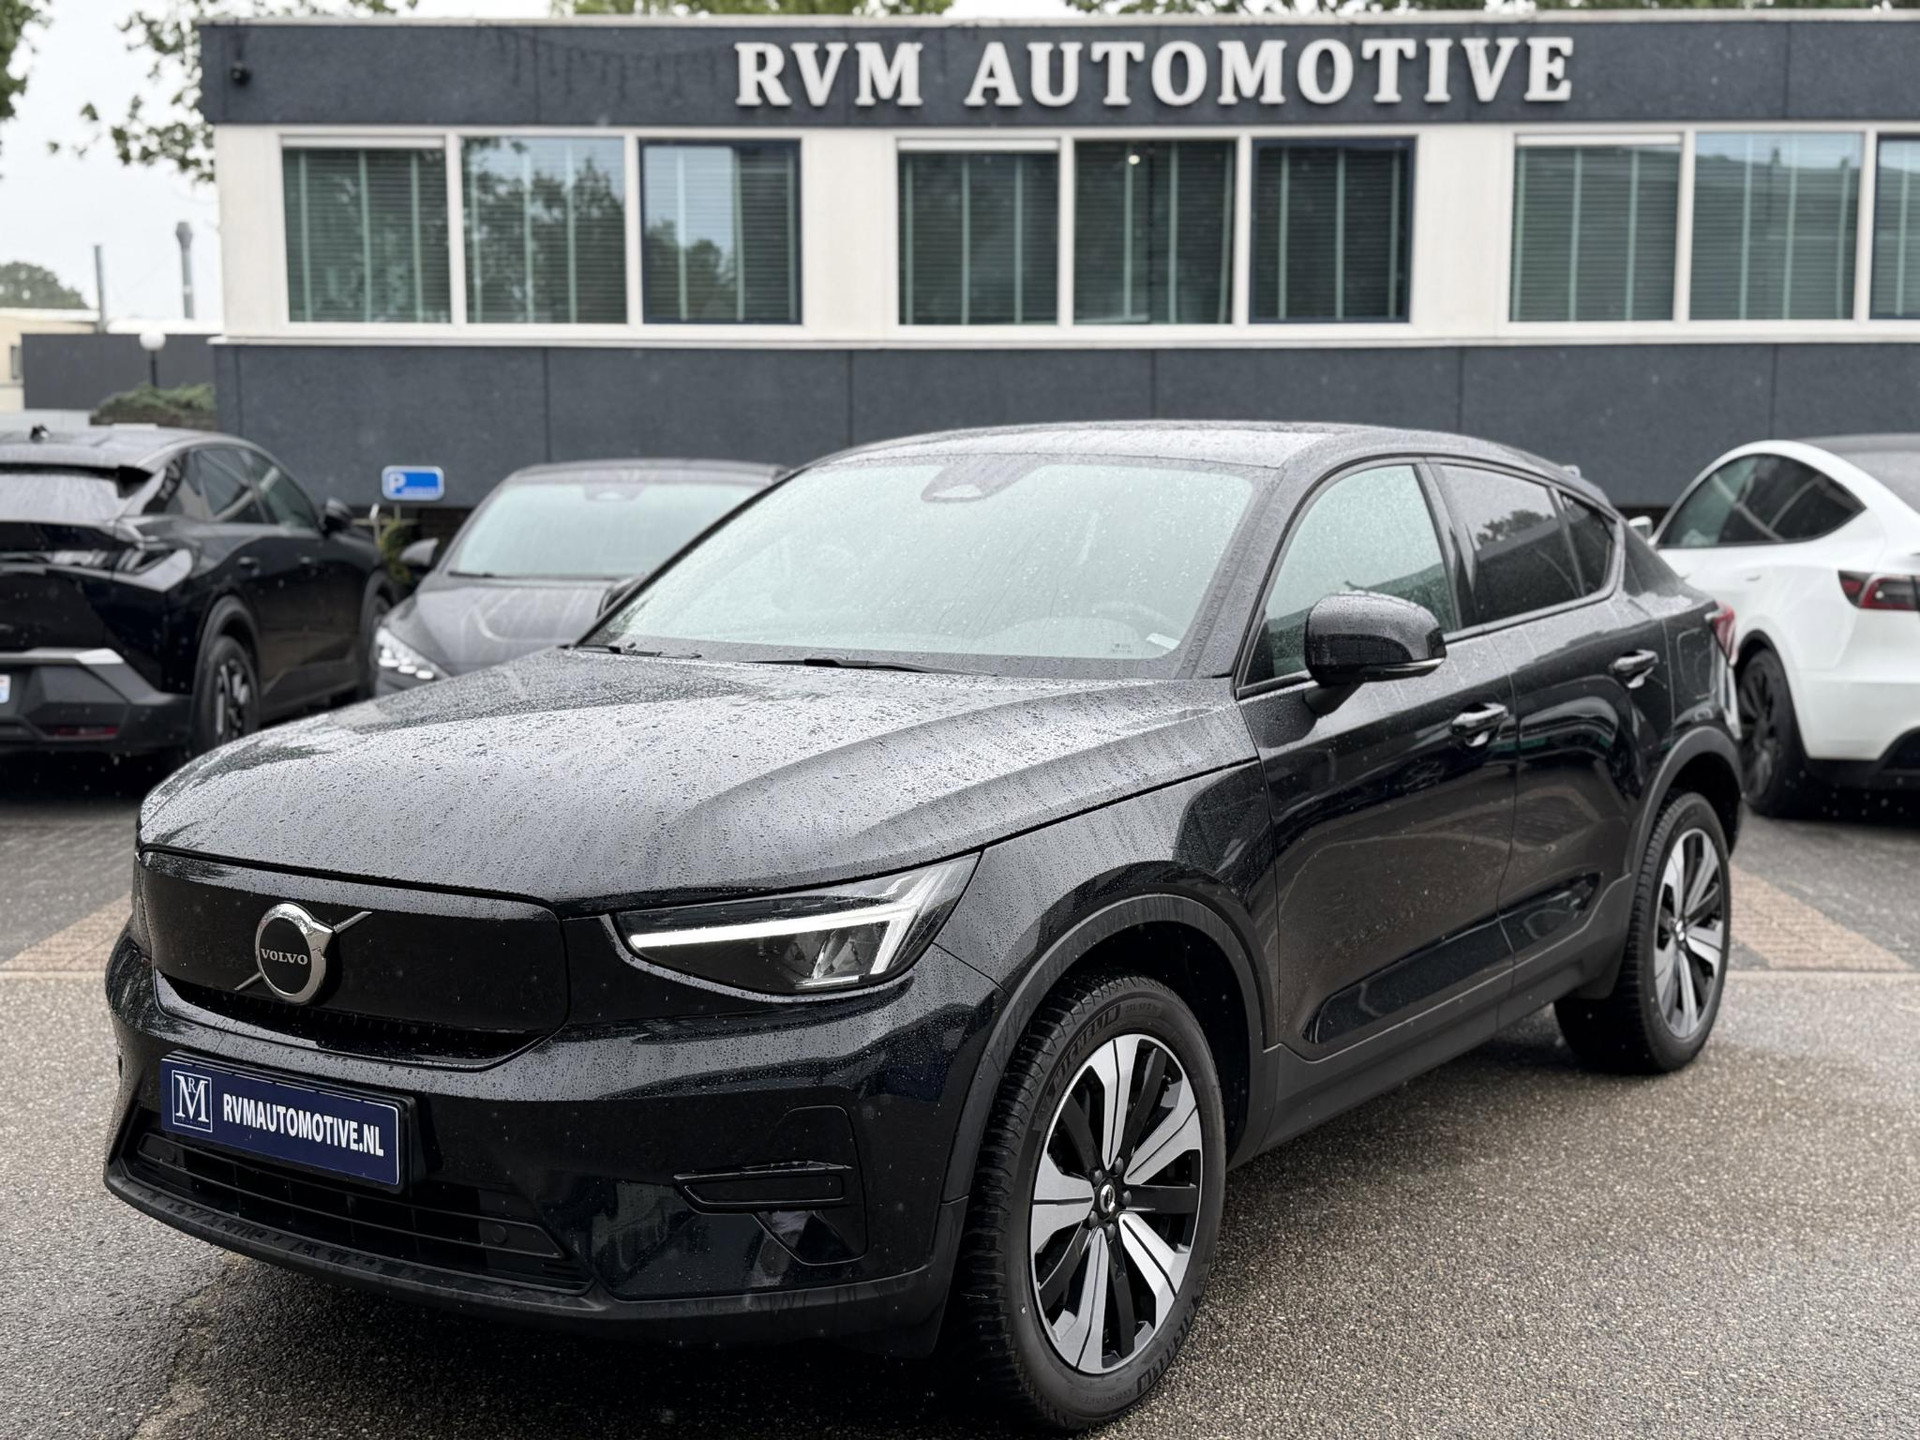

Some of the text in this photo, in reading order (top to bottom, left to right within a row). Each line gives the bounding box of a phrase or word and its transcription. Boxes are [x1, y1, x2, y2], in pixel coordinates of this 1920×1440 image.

[735, 36, 1574, 106] RVM AUTOMOTIVE
[260, 948, 309, 965] VOLVO
[223, 1093, 384, 1157] RVMAUTOMOTIVE.NL
